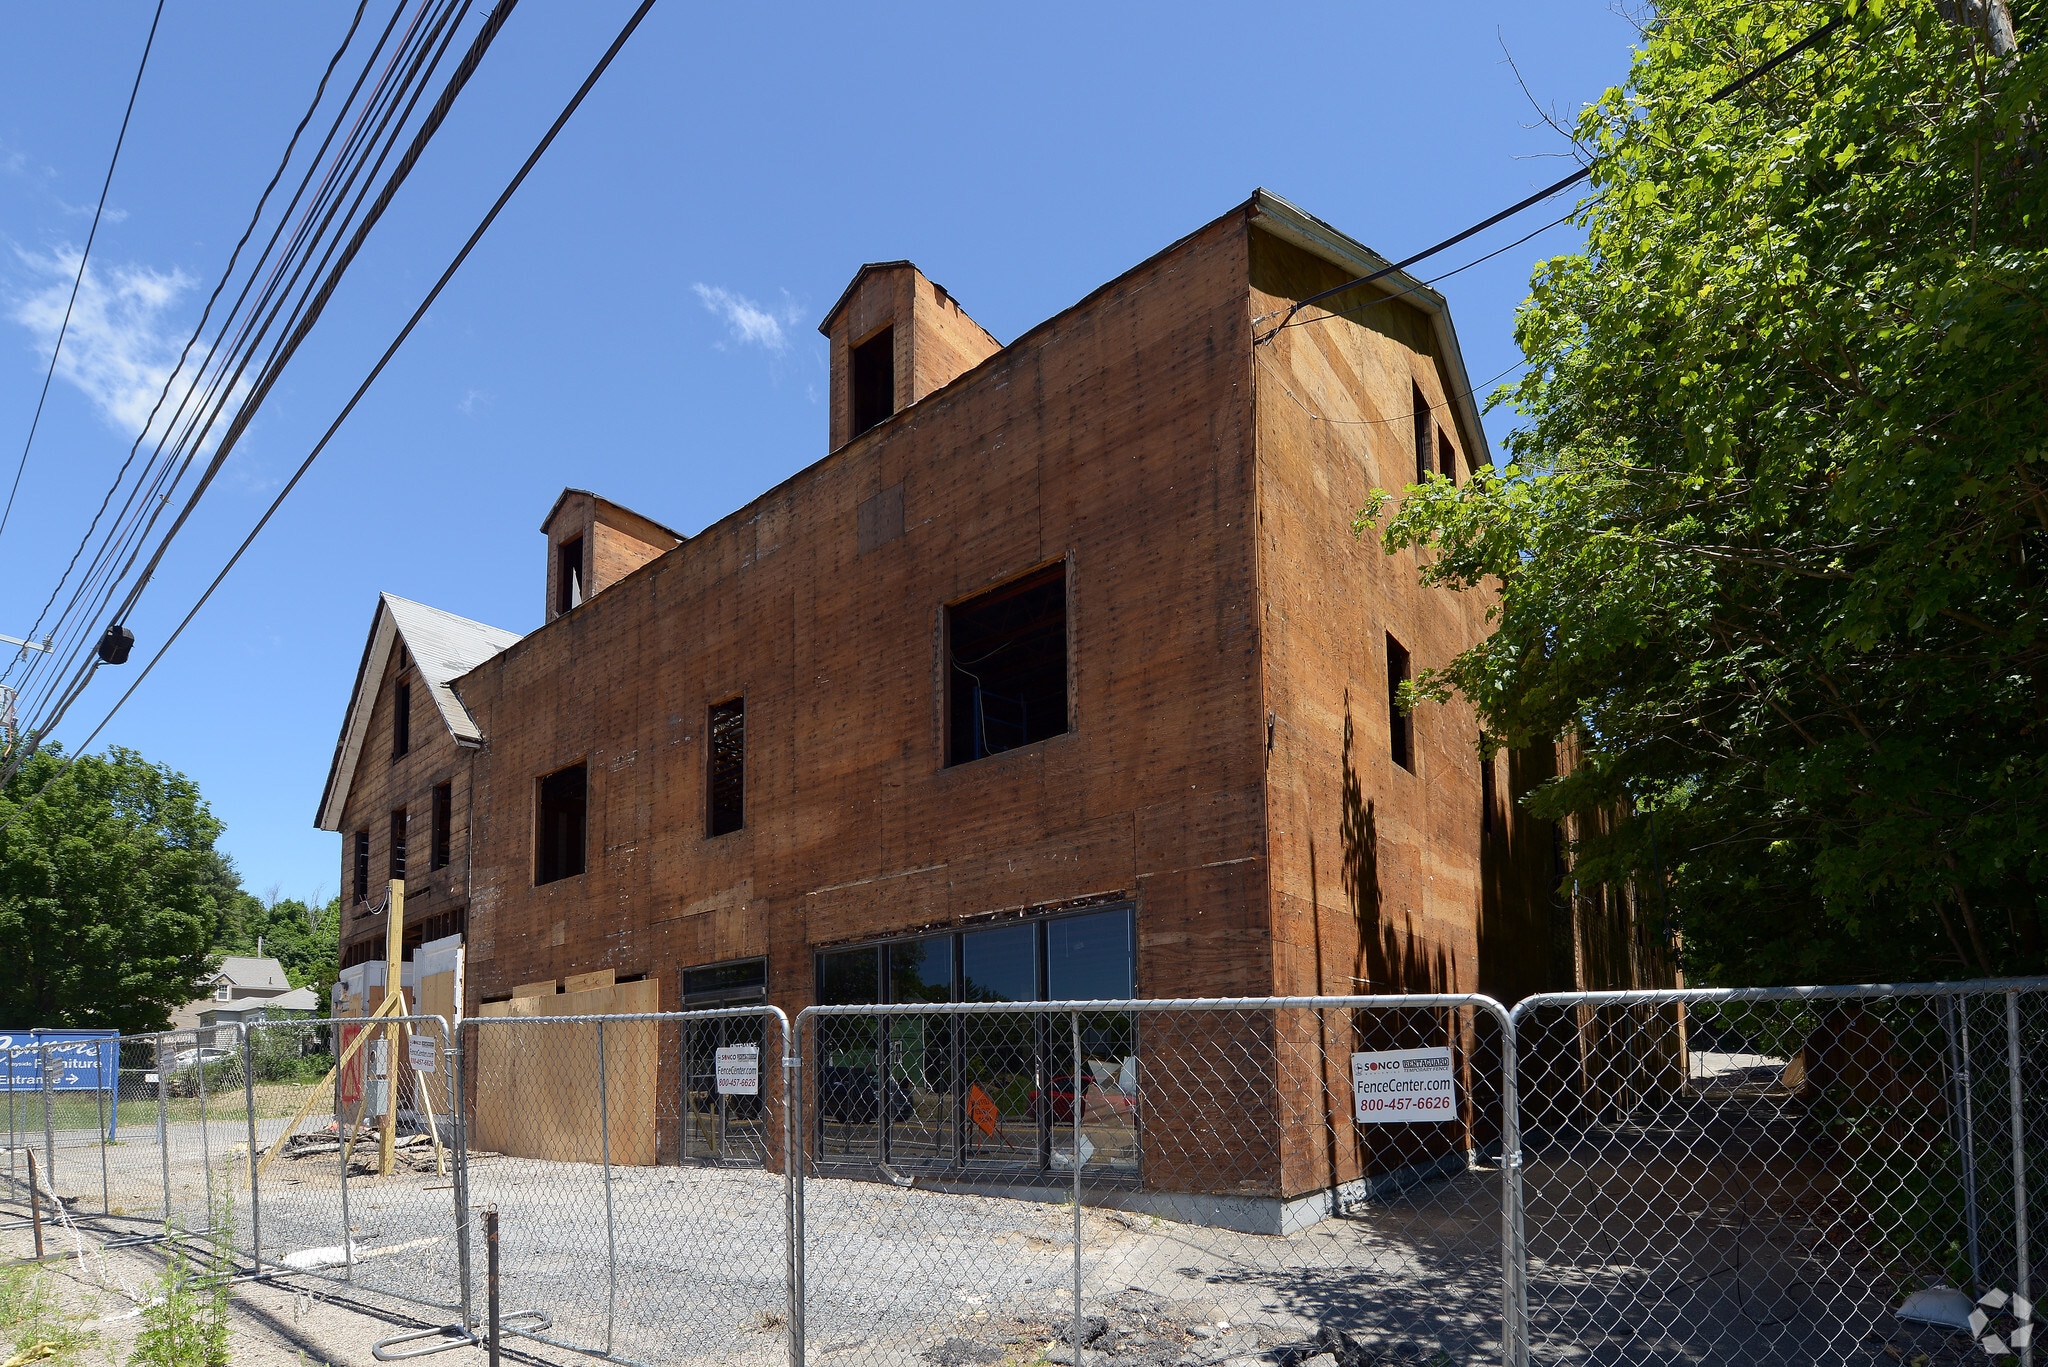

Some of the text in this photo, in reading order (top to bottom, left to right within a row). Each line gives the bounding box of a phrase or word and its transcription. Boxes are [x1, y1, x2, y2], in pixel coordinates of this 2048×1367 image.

[717, 1065, 757, 1075] FenceCenter.com
[1364, 1061, 1400, 1071] SONCO
[719, 1078, 756, 1086] 800-457-6626
[1357, 1079, 1450, 1093] FenceCenter.com
[1360, 1096, 1450, 1111] 800-457-6626
